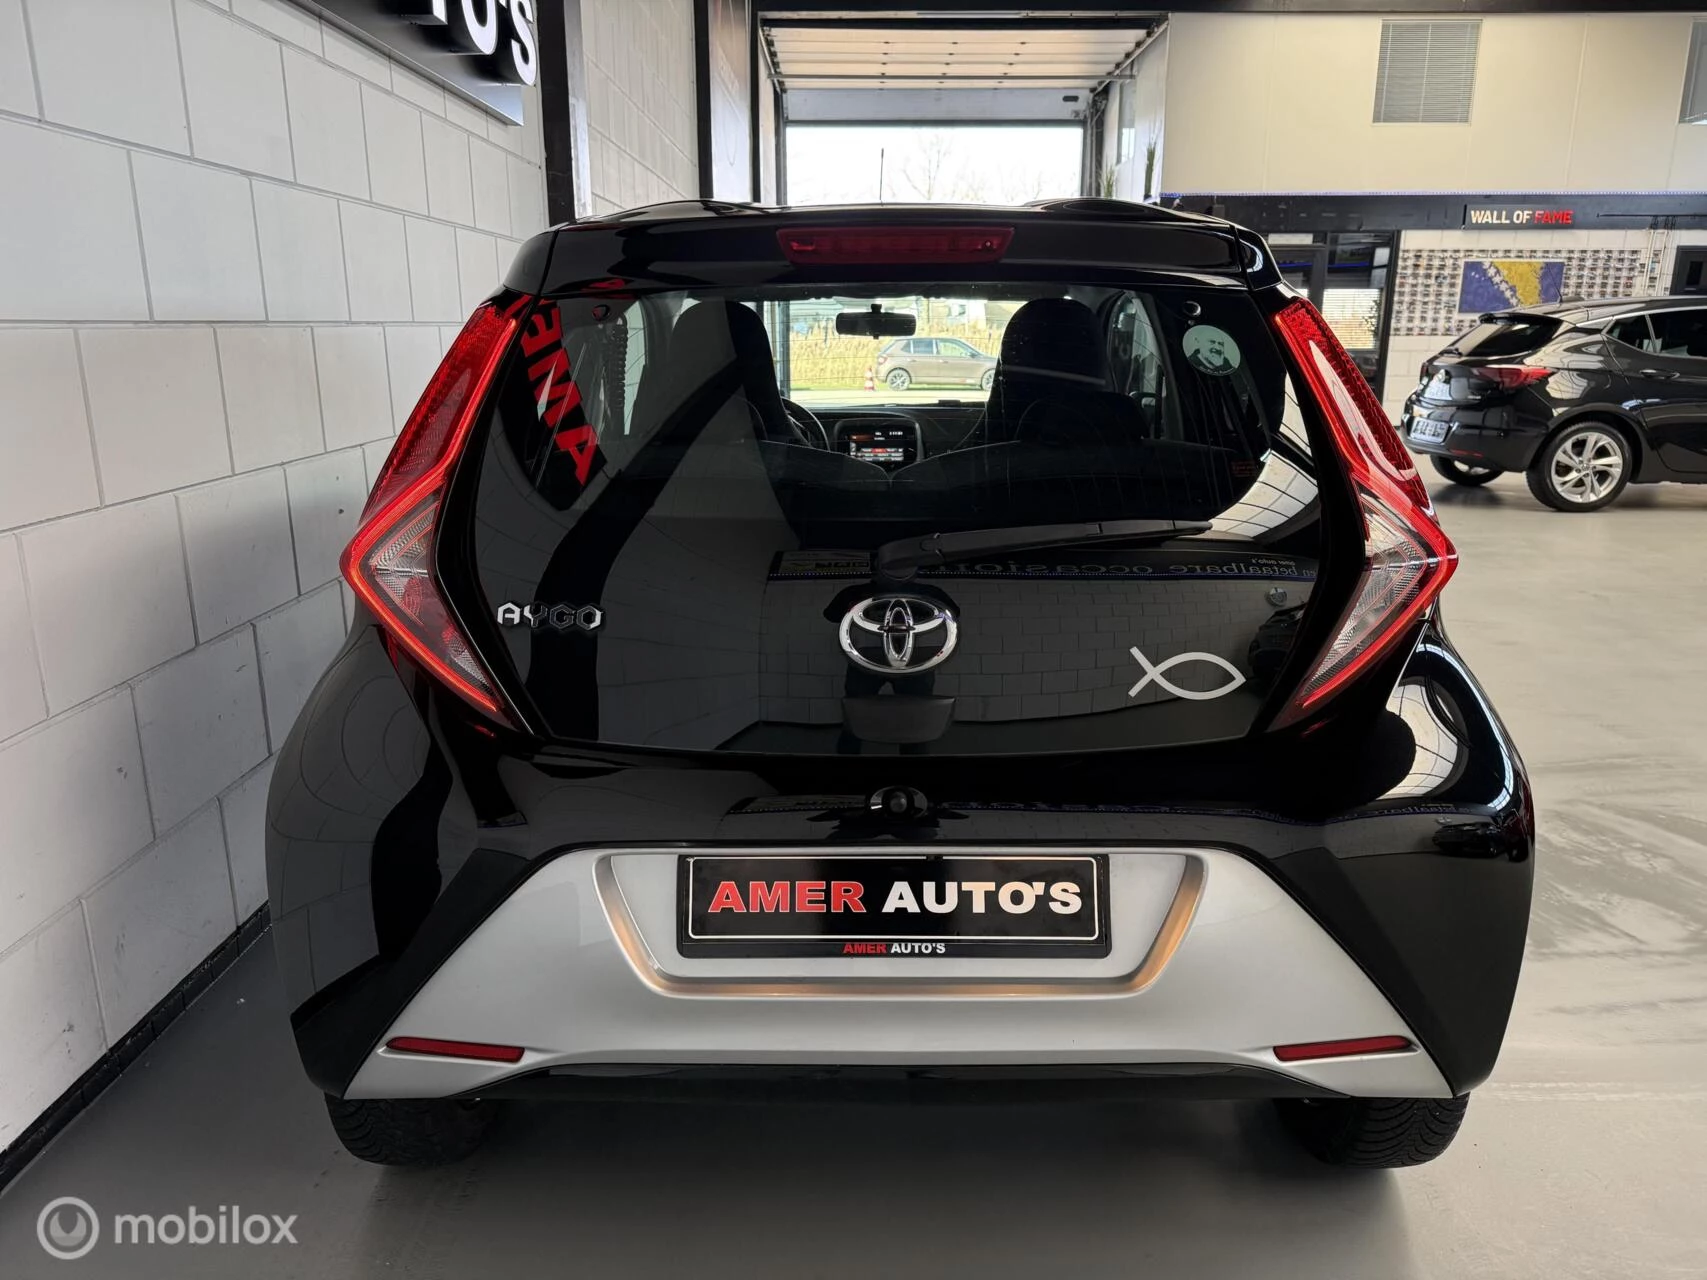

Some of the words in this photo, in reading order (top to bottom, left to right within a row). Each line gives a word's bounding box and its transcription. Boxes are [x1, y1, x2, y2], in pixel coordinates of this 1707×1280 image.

[1470, 210, 1510, 224] WALL
[1513, 210, 1532, 224] OF
[1534, 210, 1574, 224] FAME
[497, 602, 602, 630] AYGO
[707, 881, 867, 913] AMER
[882, 881, 1083, 914] AUTO'S
[843, 942, 887, 954] AMER
[890, 942, 946, 954] AUTO'S
